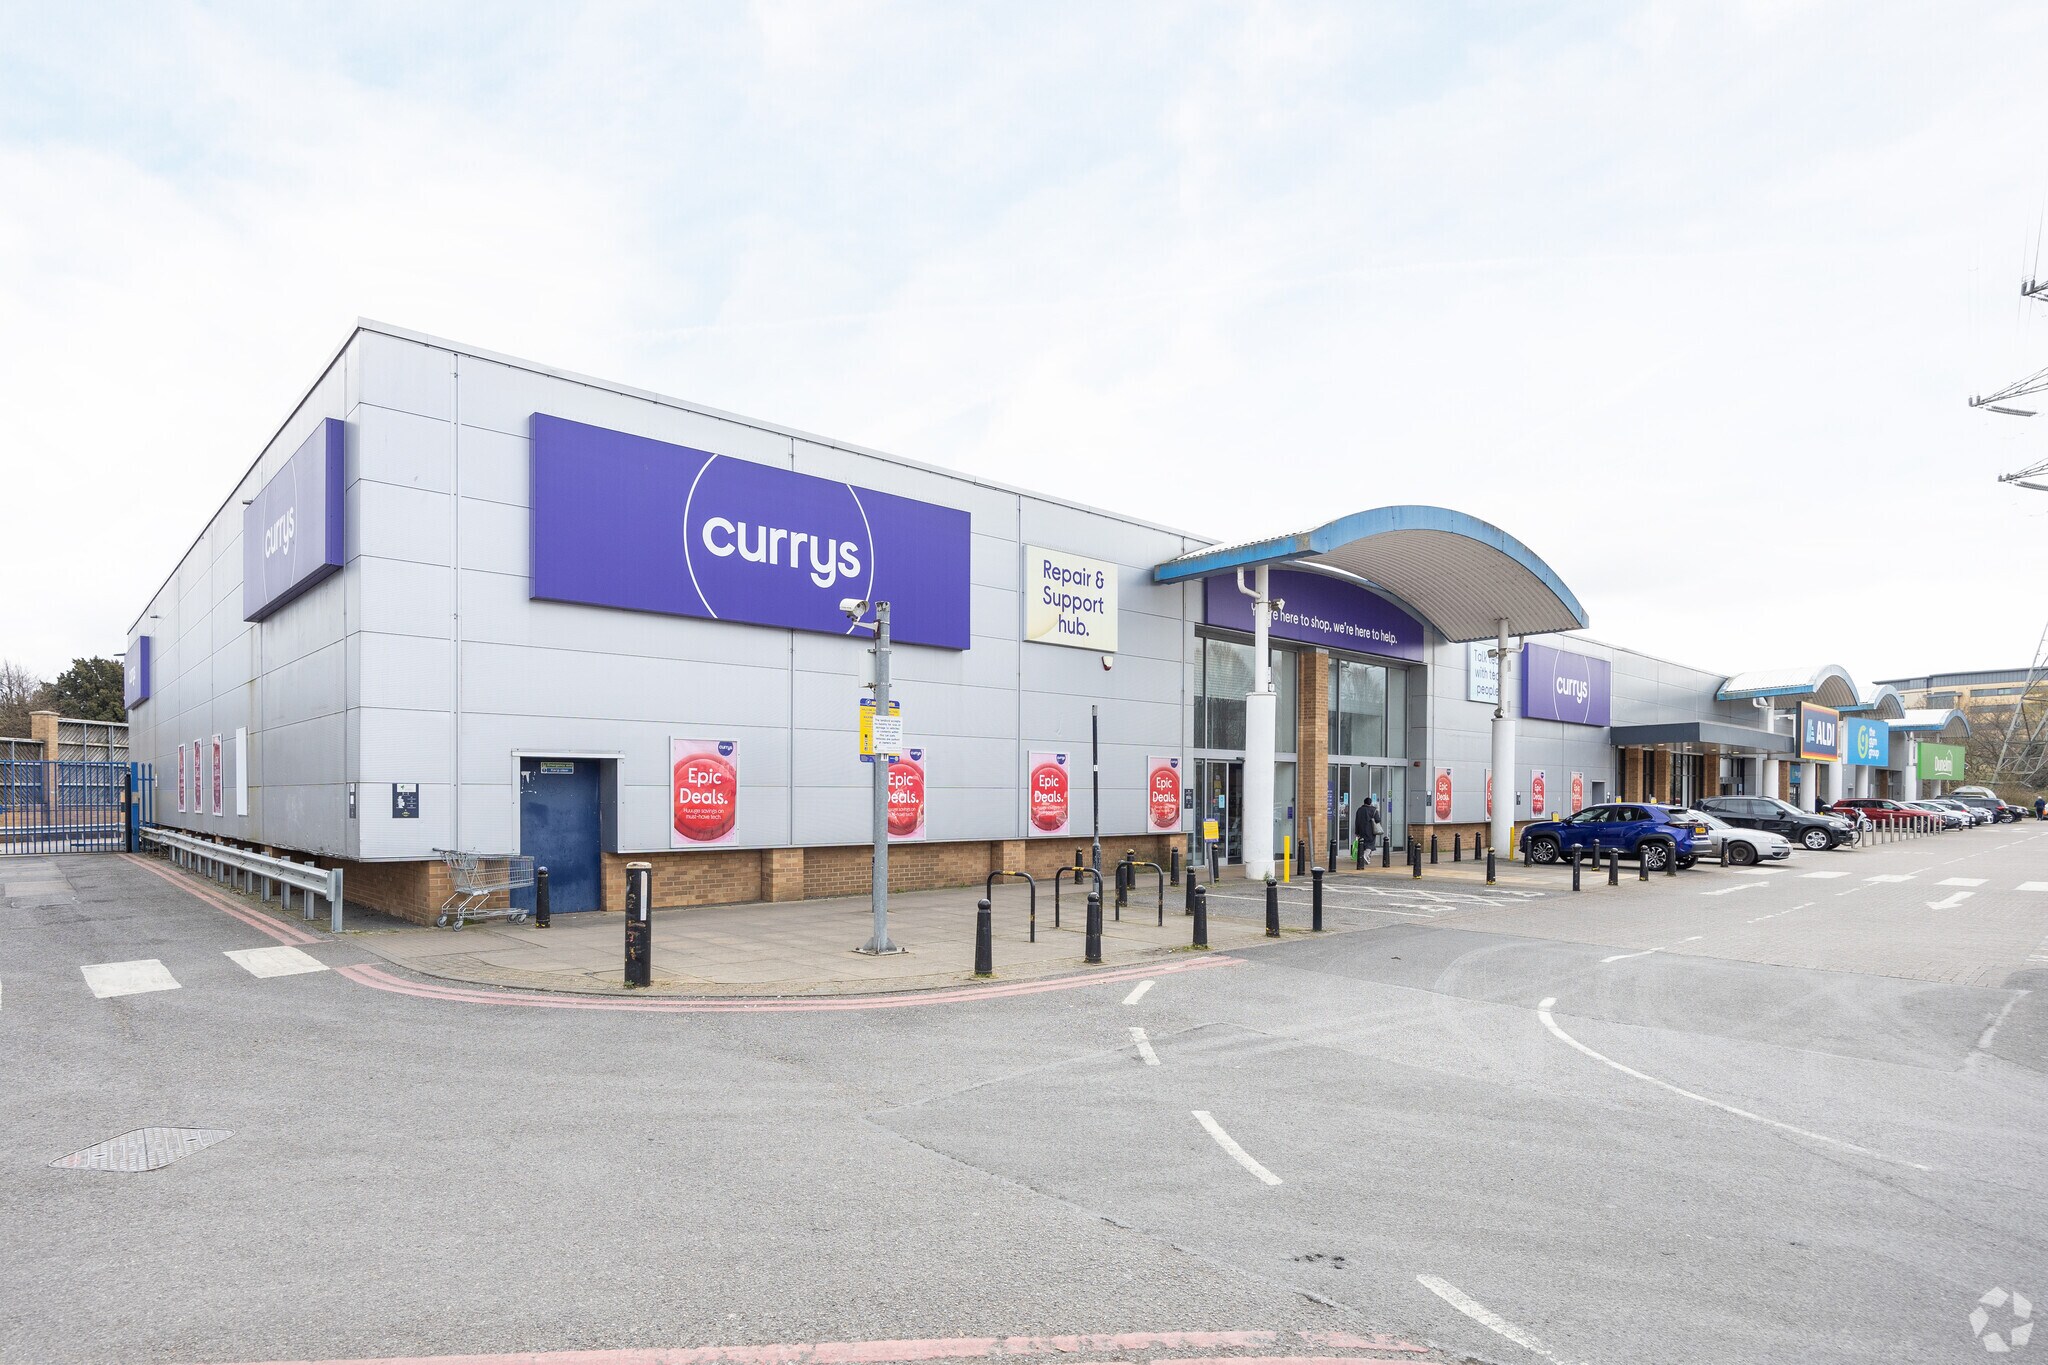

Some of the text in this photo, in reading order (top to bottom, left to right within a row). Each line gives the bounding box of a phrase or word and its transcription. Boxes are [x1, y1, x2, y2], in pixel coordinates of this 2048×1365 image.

[265, 506, 294, 558] currys
[702, 517, 861, 588] currys
[1043, 560, 1104, 589] Repair &
[1043, 586, 1104, 614] Support
[1058, 614, 1089, 636] hub.
[1280, 609, 1298, 624] here
[1300, 614, 1310, 627] to
[1311, 616, 1332, 633] shop,
[1333, 622, 1354, 635] we're
[1355, 624, 1370, 639] here
[1371, 629, 1380, 641] to
[1380, 629, 1398, 646] help.
[1474, 649, 1488, 662] Talk
[1474, 666, 1487, 680] with
[1556, 677, 1588, 704] currys
[1816, 721, 1835, 746] ALDI
[1869, 738, 1877, 748] gym
[1868, 749, 1879, 760] group
[688, 768, 722, 787] Epic
[888, 772, 913, 789] Epic
[1039, 775, 1059, 790] Epic
[1156, 777, 1172, 790] Epic
[1439, 782, 1448, 791] Epic
[680, 788, 728, 805] Deals.
[1034, 791, 1063, 803] Deals.
[1152, 792, 1176, 802] Deals.
